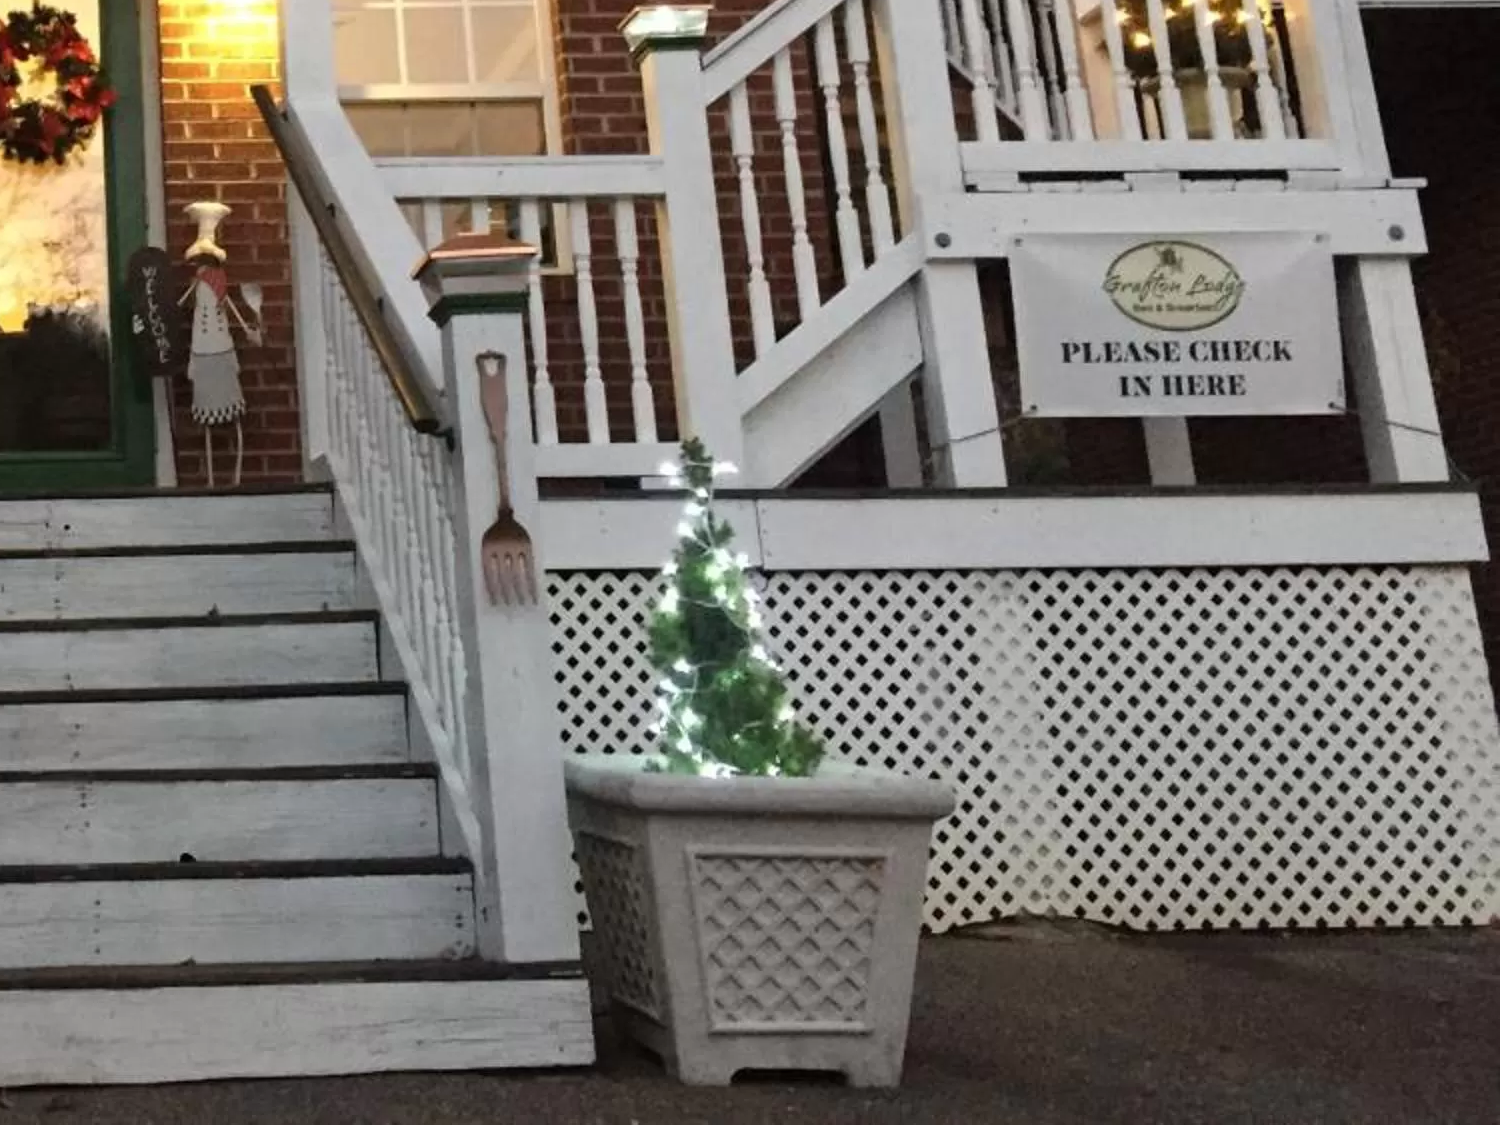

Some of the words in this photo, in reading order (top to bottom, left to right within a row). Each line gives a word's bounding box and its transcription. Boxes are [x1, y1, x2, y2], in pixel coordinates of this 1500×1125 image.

[1102, 270, 1182, 303] Grafton
[1061, 342, 1180, 363] PLEASE
[1189, 340, 1293, 362] CHECK
[1120, 376, 1152, 397] IN
[1163, 375, 1247, 396] HERE
